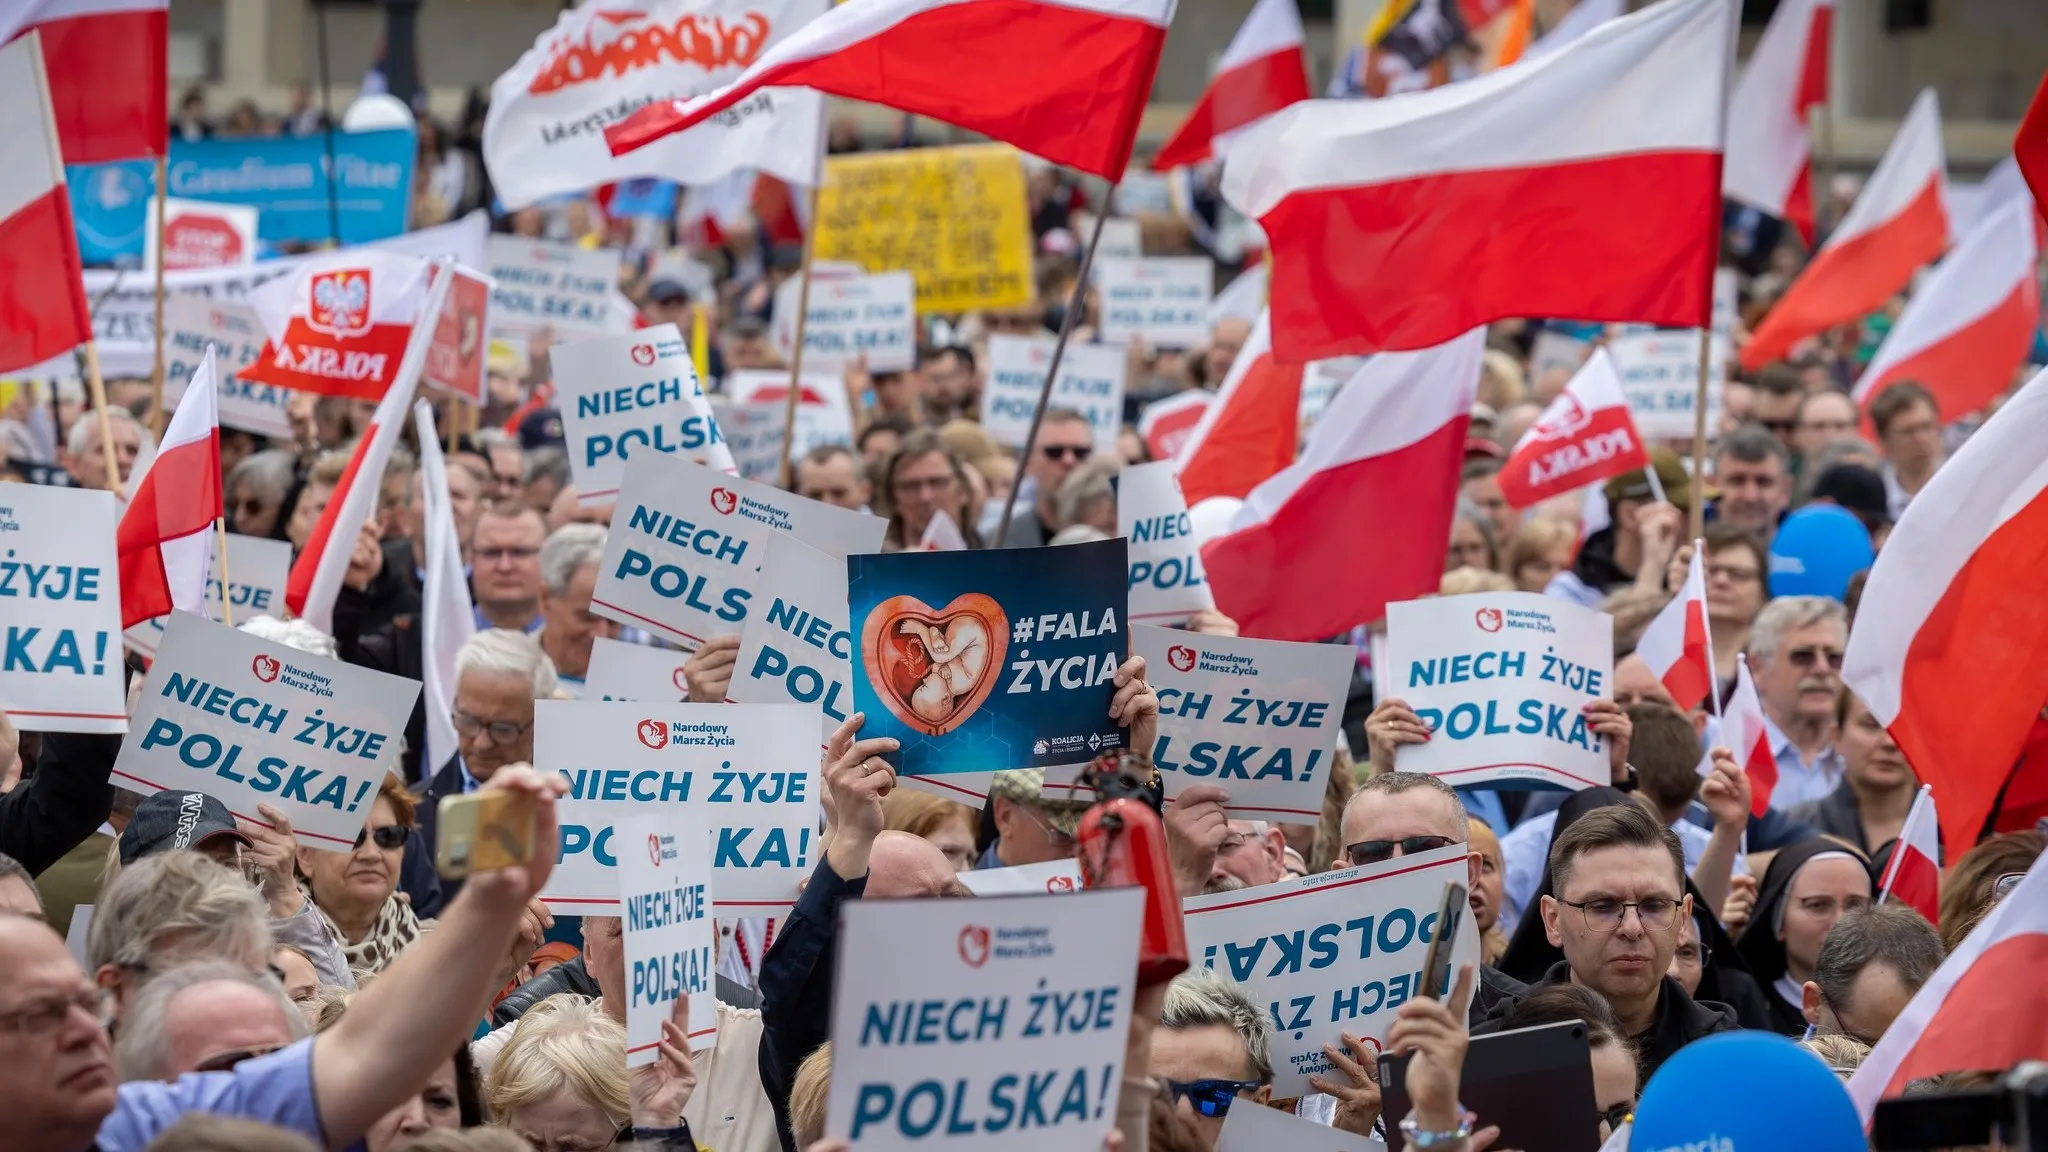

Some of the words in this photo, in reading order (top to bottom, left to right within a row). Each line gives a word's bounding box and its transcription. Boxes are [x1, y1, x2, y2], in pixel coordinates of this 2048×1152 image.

[577, 377, 680, 418] NIECH
[738, 507, 767, 524] Marsz
[767, 513, 793, 531] Życia
[741, 496, 790, 519] Narodowy
[629, 505, 749, 565] NIECH
[615, 548, 752, 622] POLS
[766, 597, 851, 660] NIEC
[1013, 607, 1118, 643] #FALA
[1506, 608, 1552, 622] Narodowy
[284, 663, 332, 686] Narodowy
[1007, 649, 1121, 694] ŻYCIA
[1199, 662, 1230, 674] Marsz
[1230, 661, 1259, 677] Życia
[1201, 650, 1254, 666] Narodowy
[1408, 651, 1526, 687] NIECH
[1540, 645, 1602, 697] ŻYJE
[280, 674, 308, 691] Marsz
[309, 680, 334, 698] Życia
[161, 671, 288, 734] NIECH
[294, 708, 388, 760] ŻYJE
[673, 722, 728, 735] Narodowy
[1223, 688, 1330, 729] ŻYJE
[673, 735, 706, 746] Marsz
[707, 732, 735, 748] Życia
[1051, 735, 1084, 746] KOALICJA
[1152, 736, 1324, 783] LSKA!
[140, 717, 372, 813] POLSKA!
[558, 768, 693, 802] NIECH
[707, 760, 808, 803] ŻYJE
[555, 824, 810, 868] POKA!
[1301, 869, 1359, 886] afirmacja.info
[628, 889, 672, 932] NIECH
[675, 876, 705, 924] ŻYJE
[633, 946, 709, 1008] POLSKA!
[858, 996, 1010, 1047] NIECH
[1021, 977, 1120, 1038] ŻYJE
[1290, 1049, 1319, 1065] Życia
[848, 1063, 1115, 1141] POLSKA!
